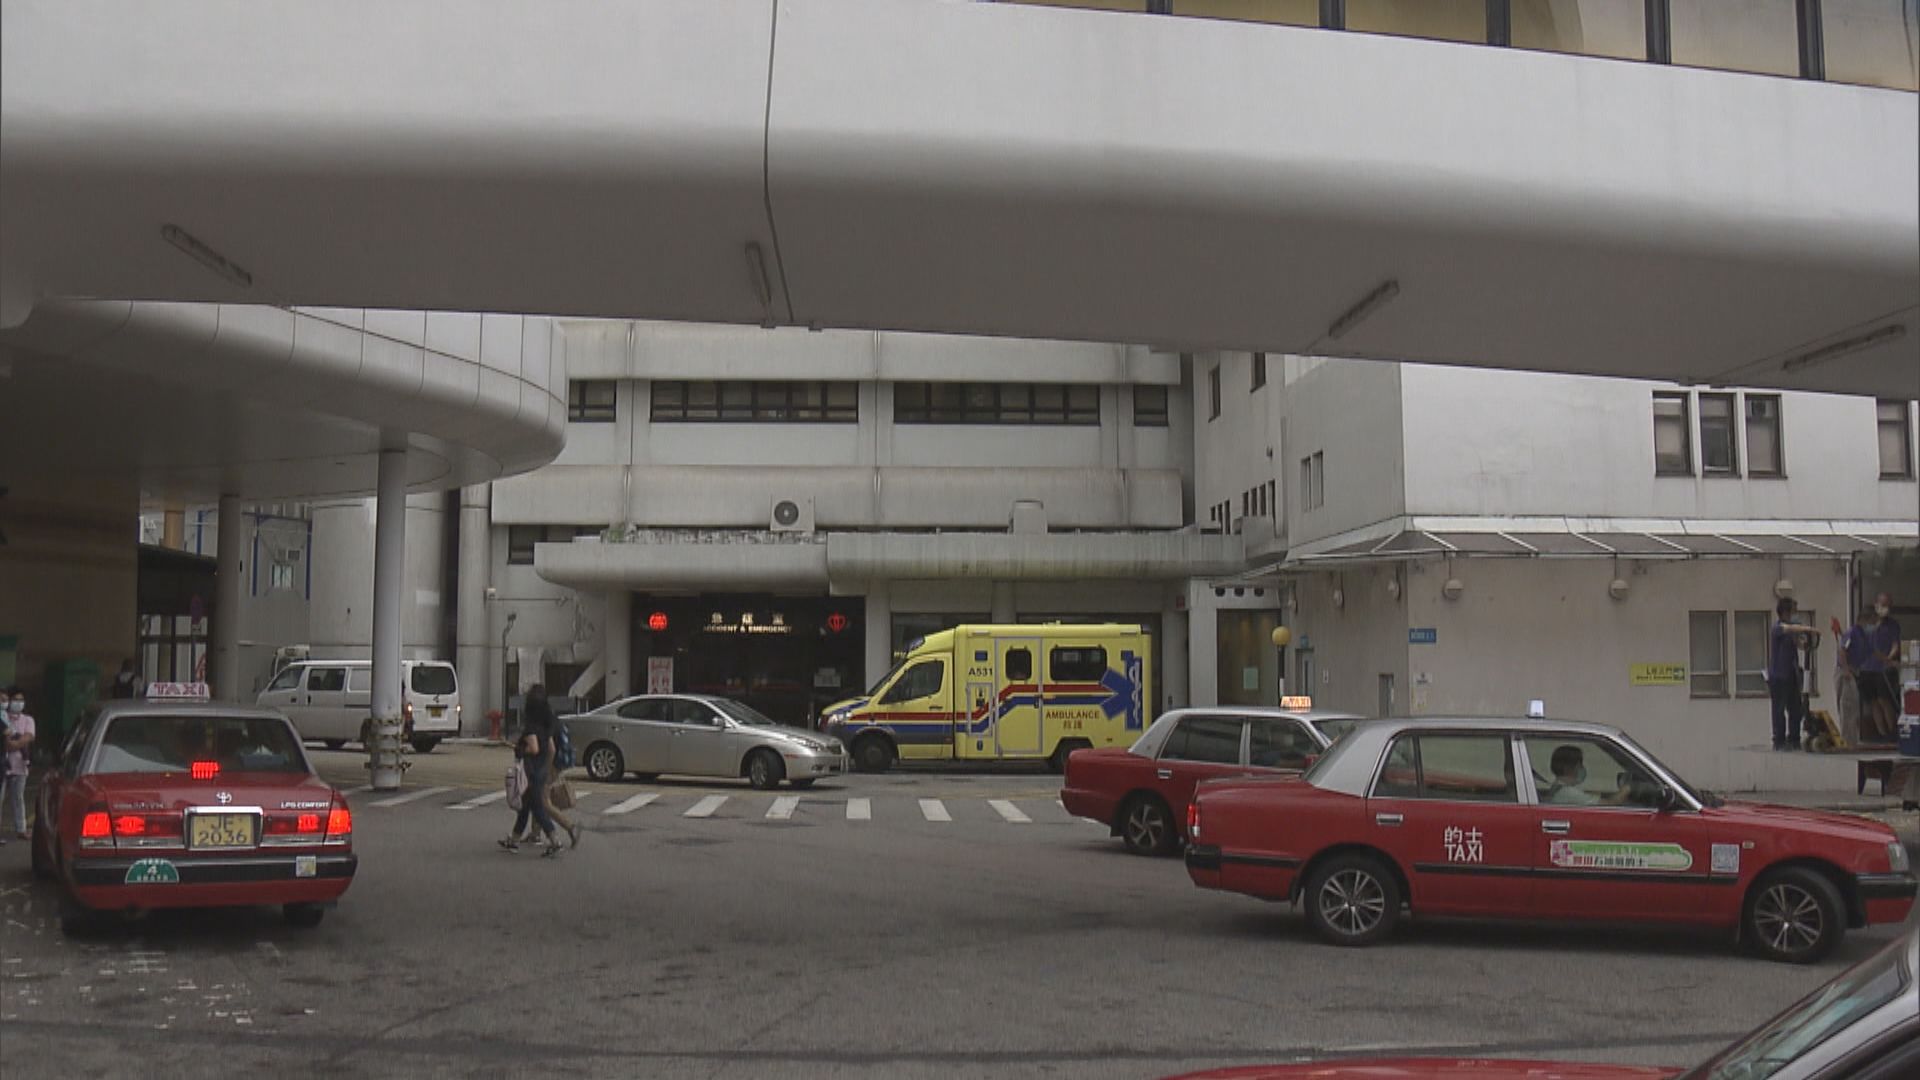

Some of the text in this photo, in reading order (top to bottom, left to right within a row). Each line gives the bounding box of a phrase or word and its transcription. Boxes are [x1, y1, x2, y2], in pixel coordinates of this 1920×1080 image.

[968, 667, 993, 676] A531
[154, 683, 205, 696] TAXI
[1046, 710, 1100, 720] AMBULANCE
[199, 830, 247, 844] 2036
[1444, 826, 1483, 844] 的士
[1444, 843, 1483, 861] TAXI
